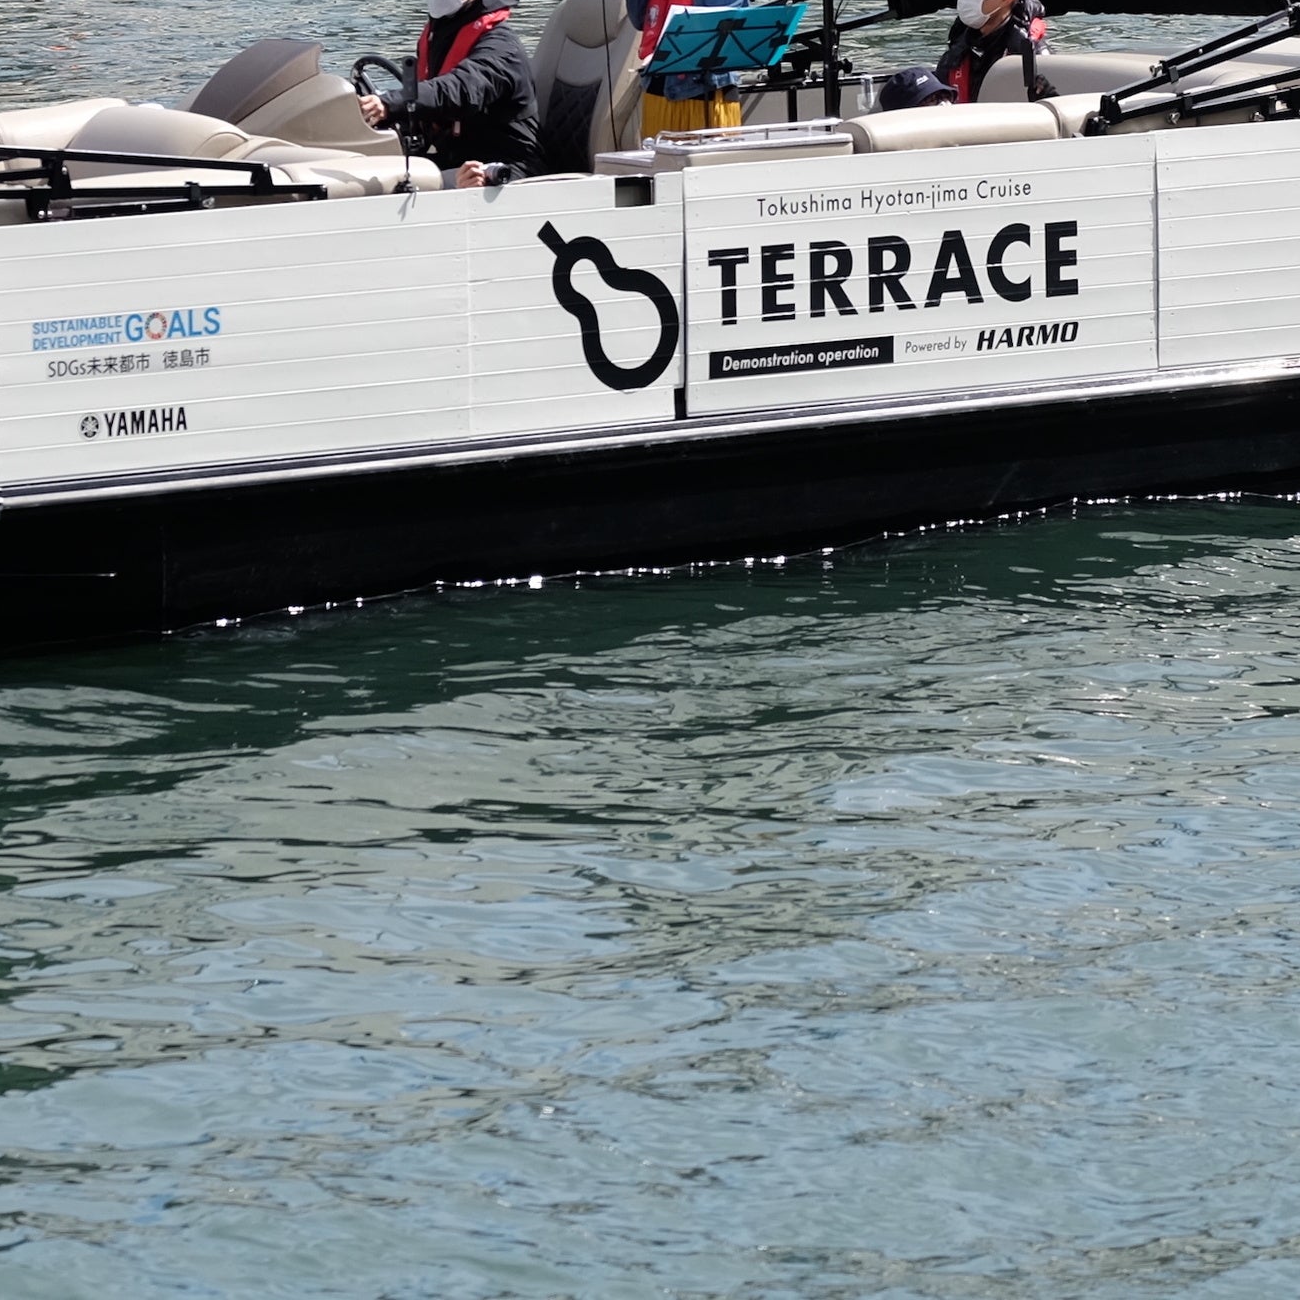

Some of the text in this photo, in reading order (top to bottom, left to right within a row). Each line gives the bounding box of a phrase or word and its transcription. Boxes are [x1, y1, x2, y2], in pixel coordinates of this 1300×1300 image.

[757, 178, 1032, 217] Tokushima Hyotan-jima Cruise
[707, 219, 1080, 326] TERRACE
[32, 315, 122, 335] SUSTAINABLE
[32, 331, 122, 350] DEVELOPMENT
[125, 307, 221, 342] GOALS
[904, 321, 1080, 354] Powered by HARMO
[48, 347, 210, 378] SDGs未来都市 徳島市
[722, 345, 880, 372] Demonstration operation
[104, 406, 189, 438] YAMAHA
